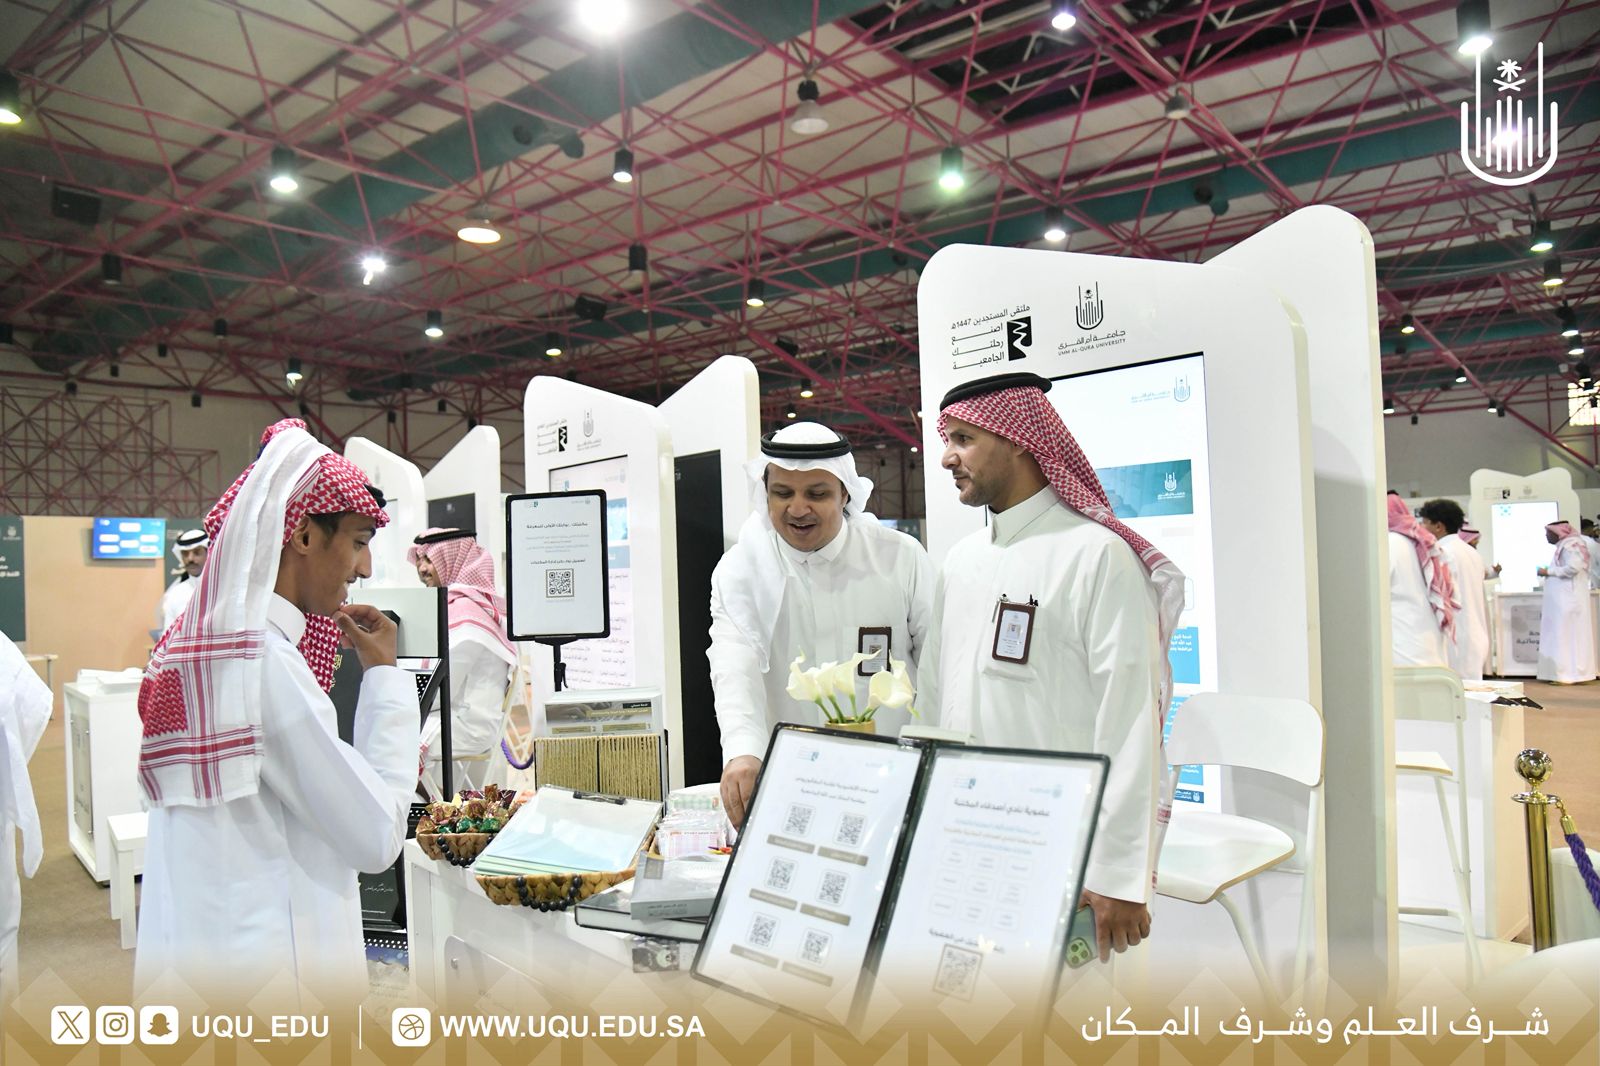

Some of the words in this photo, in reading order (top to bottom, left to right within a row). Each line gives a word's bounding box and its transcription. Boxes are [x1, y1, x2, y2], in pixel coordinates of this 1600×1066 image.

[973, 309, 1008, 325] المستجدين
[1010, 304, 1030, 317] ملتقى
[951, 322, 1003, 345] اصنع
[1085, 334, 1093, 344] أم
[1093, 330, 1126, 342] جامعة
[952, 339, 1004, 356] رحلتك
[1058, 337, 1084, 350] القرى
[1072, 344, 1094, 353] AL-QURA
[1096, 338, 1126, 348] UNIVERSITY
[952, 351, 1005, 370] الجامعية
